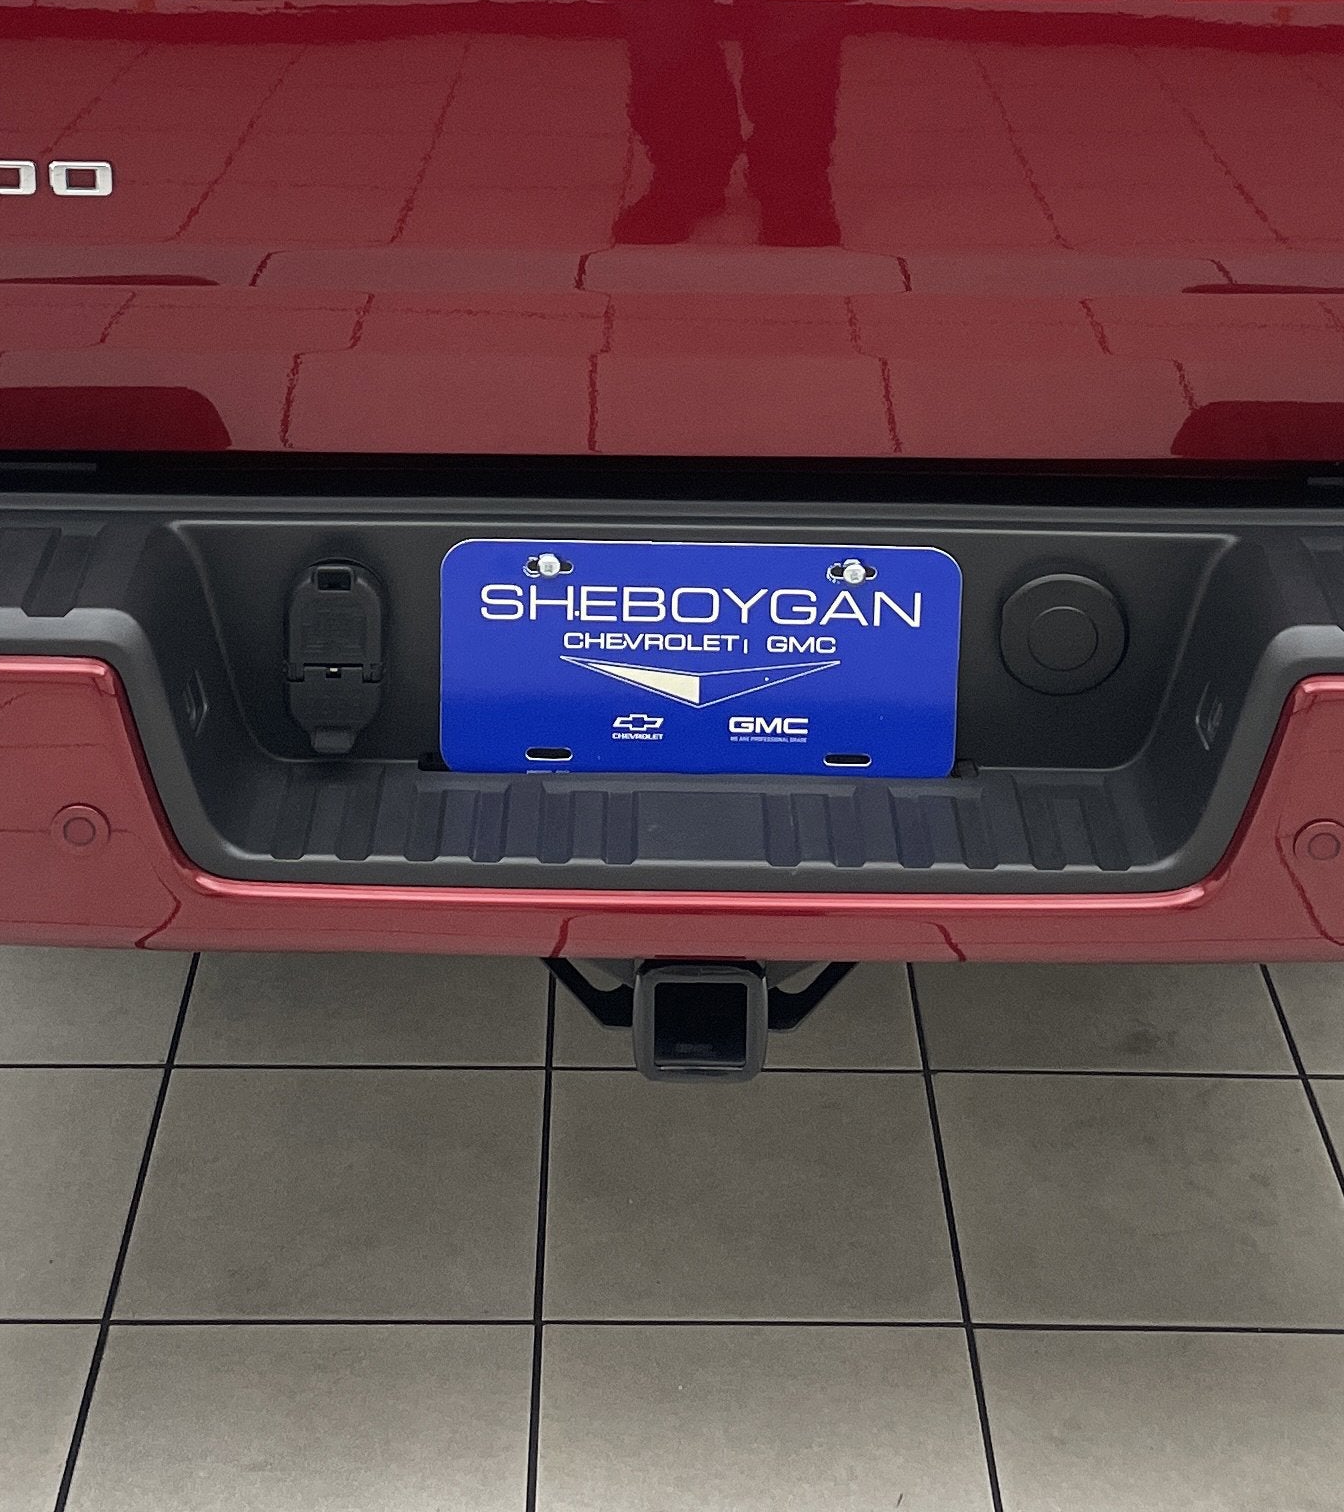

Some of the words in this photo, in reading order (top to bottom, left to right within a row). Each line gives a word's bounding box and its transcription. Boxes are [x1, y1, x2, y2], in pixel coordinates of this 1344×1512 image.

[480, 584, 923, 629] SHEBOYGAN
[563, 632, 740, 653] CHEVROLET
[766, 635, 837, 654] GMC
[728, 716, 809, 735] GMC
[611, 732, 664, 741] CHEVROLET
